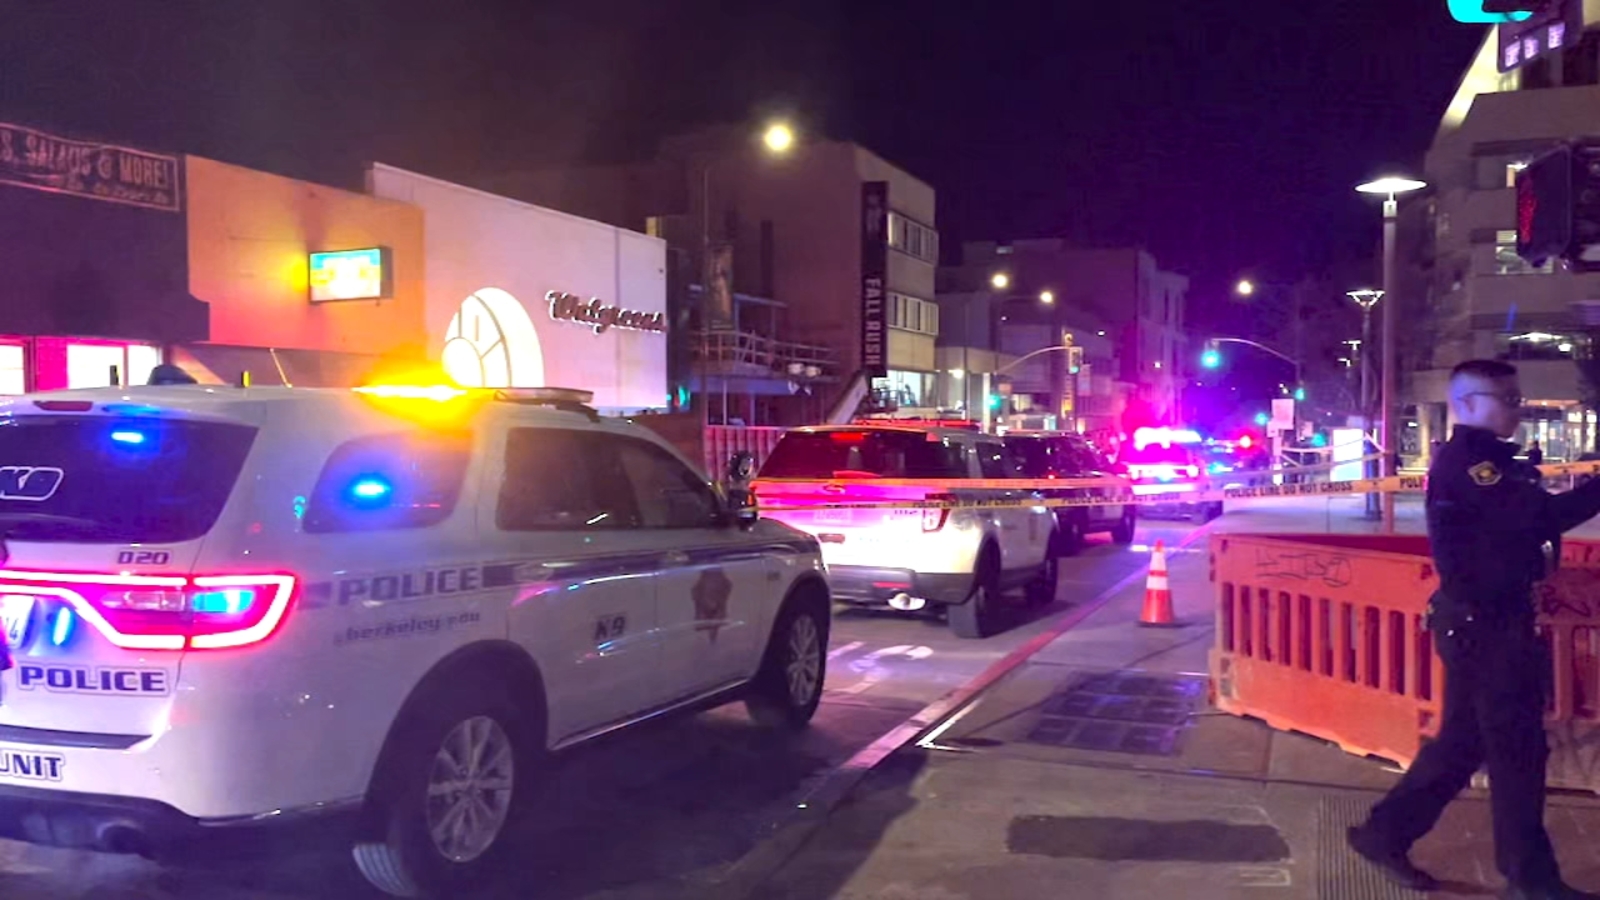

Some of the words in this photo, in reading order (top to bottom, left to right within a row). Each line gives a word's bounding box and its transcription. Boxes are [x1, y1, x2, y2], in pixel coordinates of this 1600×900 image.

[865, 278, 881, 317] FALL
[865, 321, 881, 365] RUSH
[1225, 487, 1257, 498] POLICE
[1260, 487, 1280, 497] LINE
[1284, 485, 1296, 495] DO
[1299, 483, 1317, 494] NOT
[1320, 480, 1353, 492] CROSS
[1400, 477, 1424, 489] POLI
[337, 567, 479, 606] POLICE
[19, 665, 166, 692] POLICE
